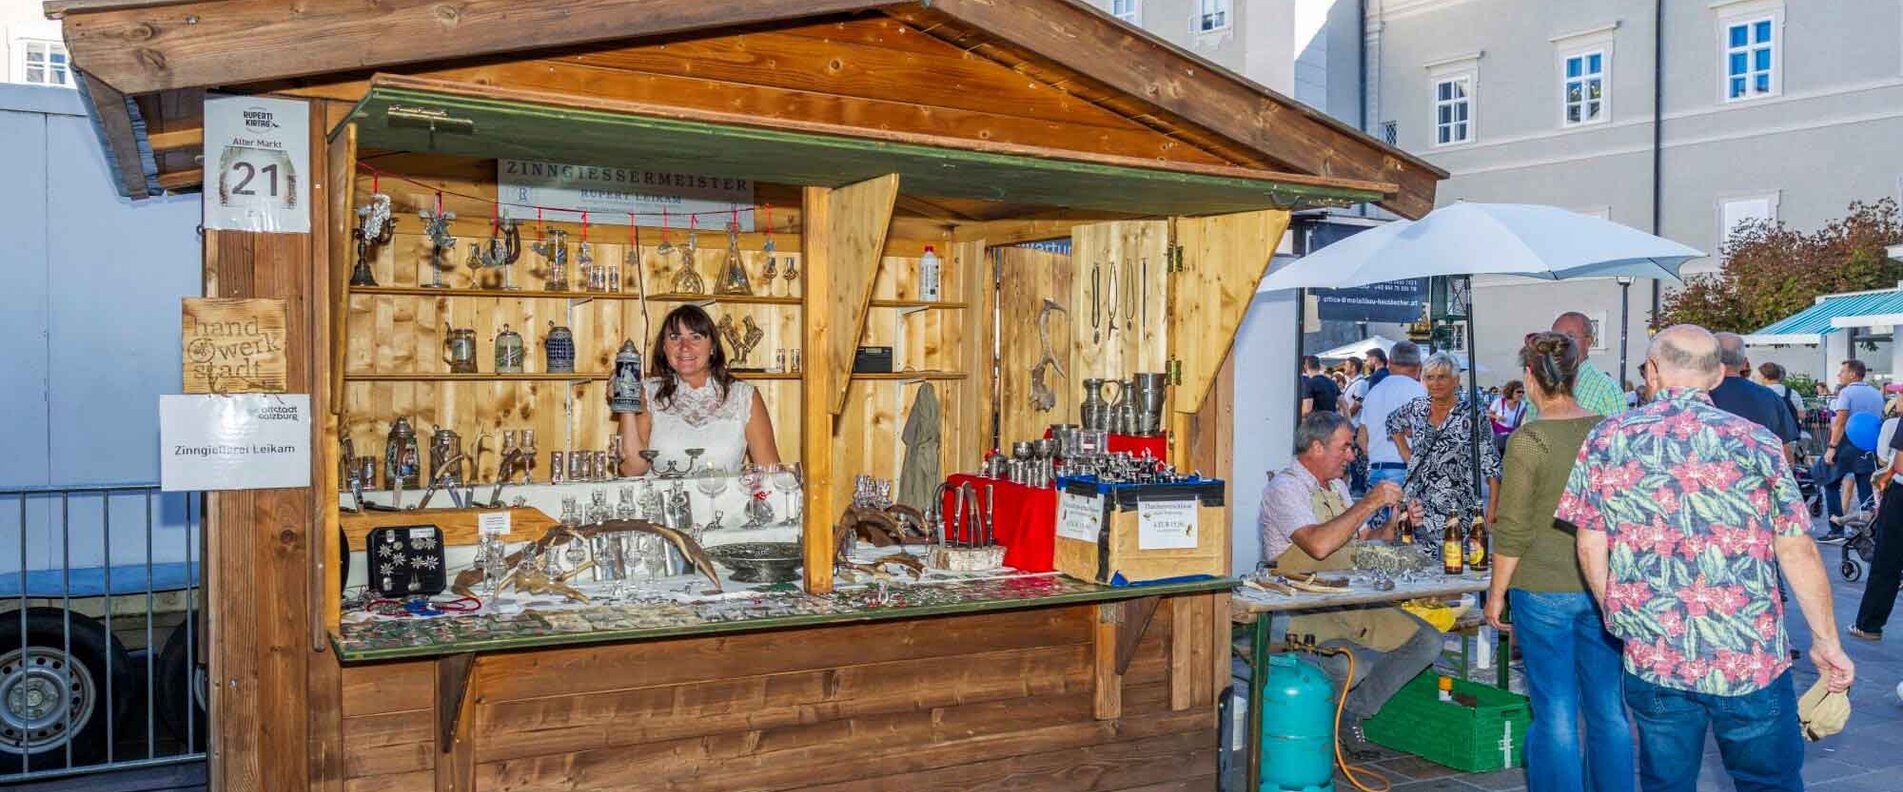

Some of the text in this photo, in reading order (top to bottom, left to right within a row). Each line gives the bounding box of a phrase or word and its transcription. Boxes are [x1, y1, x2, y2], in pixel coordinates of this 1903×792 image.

[243, 110, 273, 120] RUPERTI
[245, 119, 271, 128] KIRTAG
[233, 138, 282, 149] Alter Markt
[231, 161, 278, 197] 21
[506, 161, 747, 191] ZINNGIESSERMEISTER
[193, 315, 260, 337] hand
[217, 332, 281, 361] werk
[193, 357, 260, 380] stadt
[261, 405, 298, 414] altstadt
[258, 412, 298, 421] salzburg
[253, 443, 295, 454] Leikam
